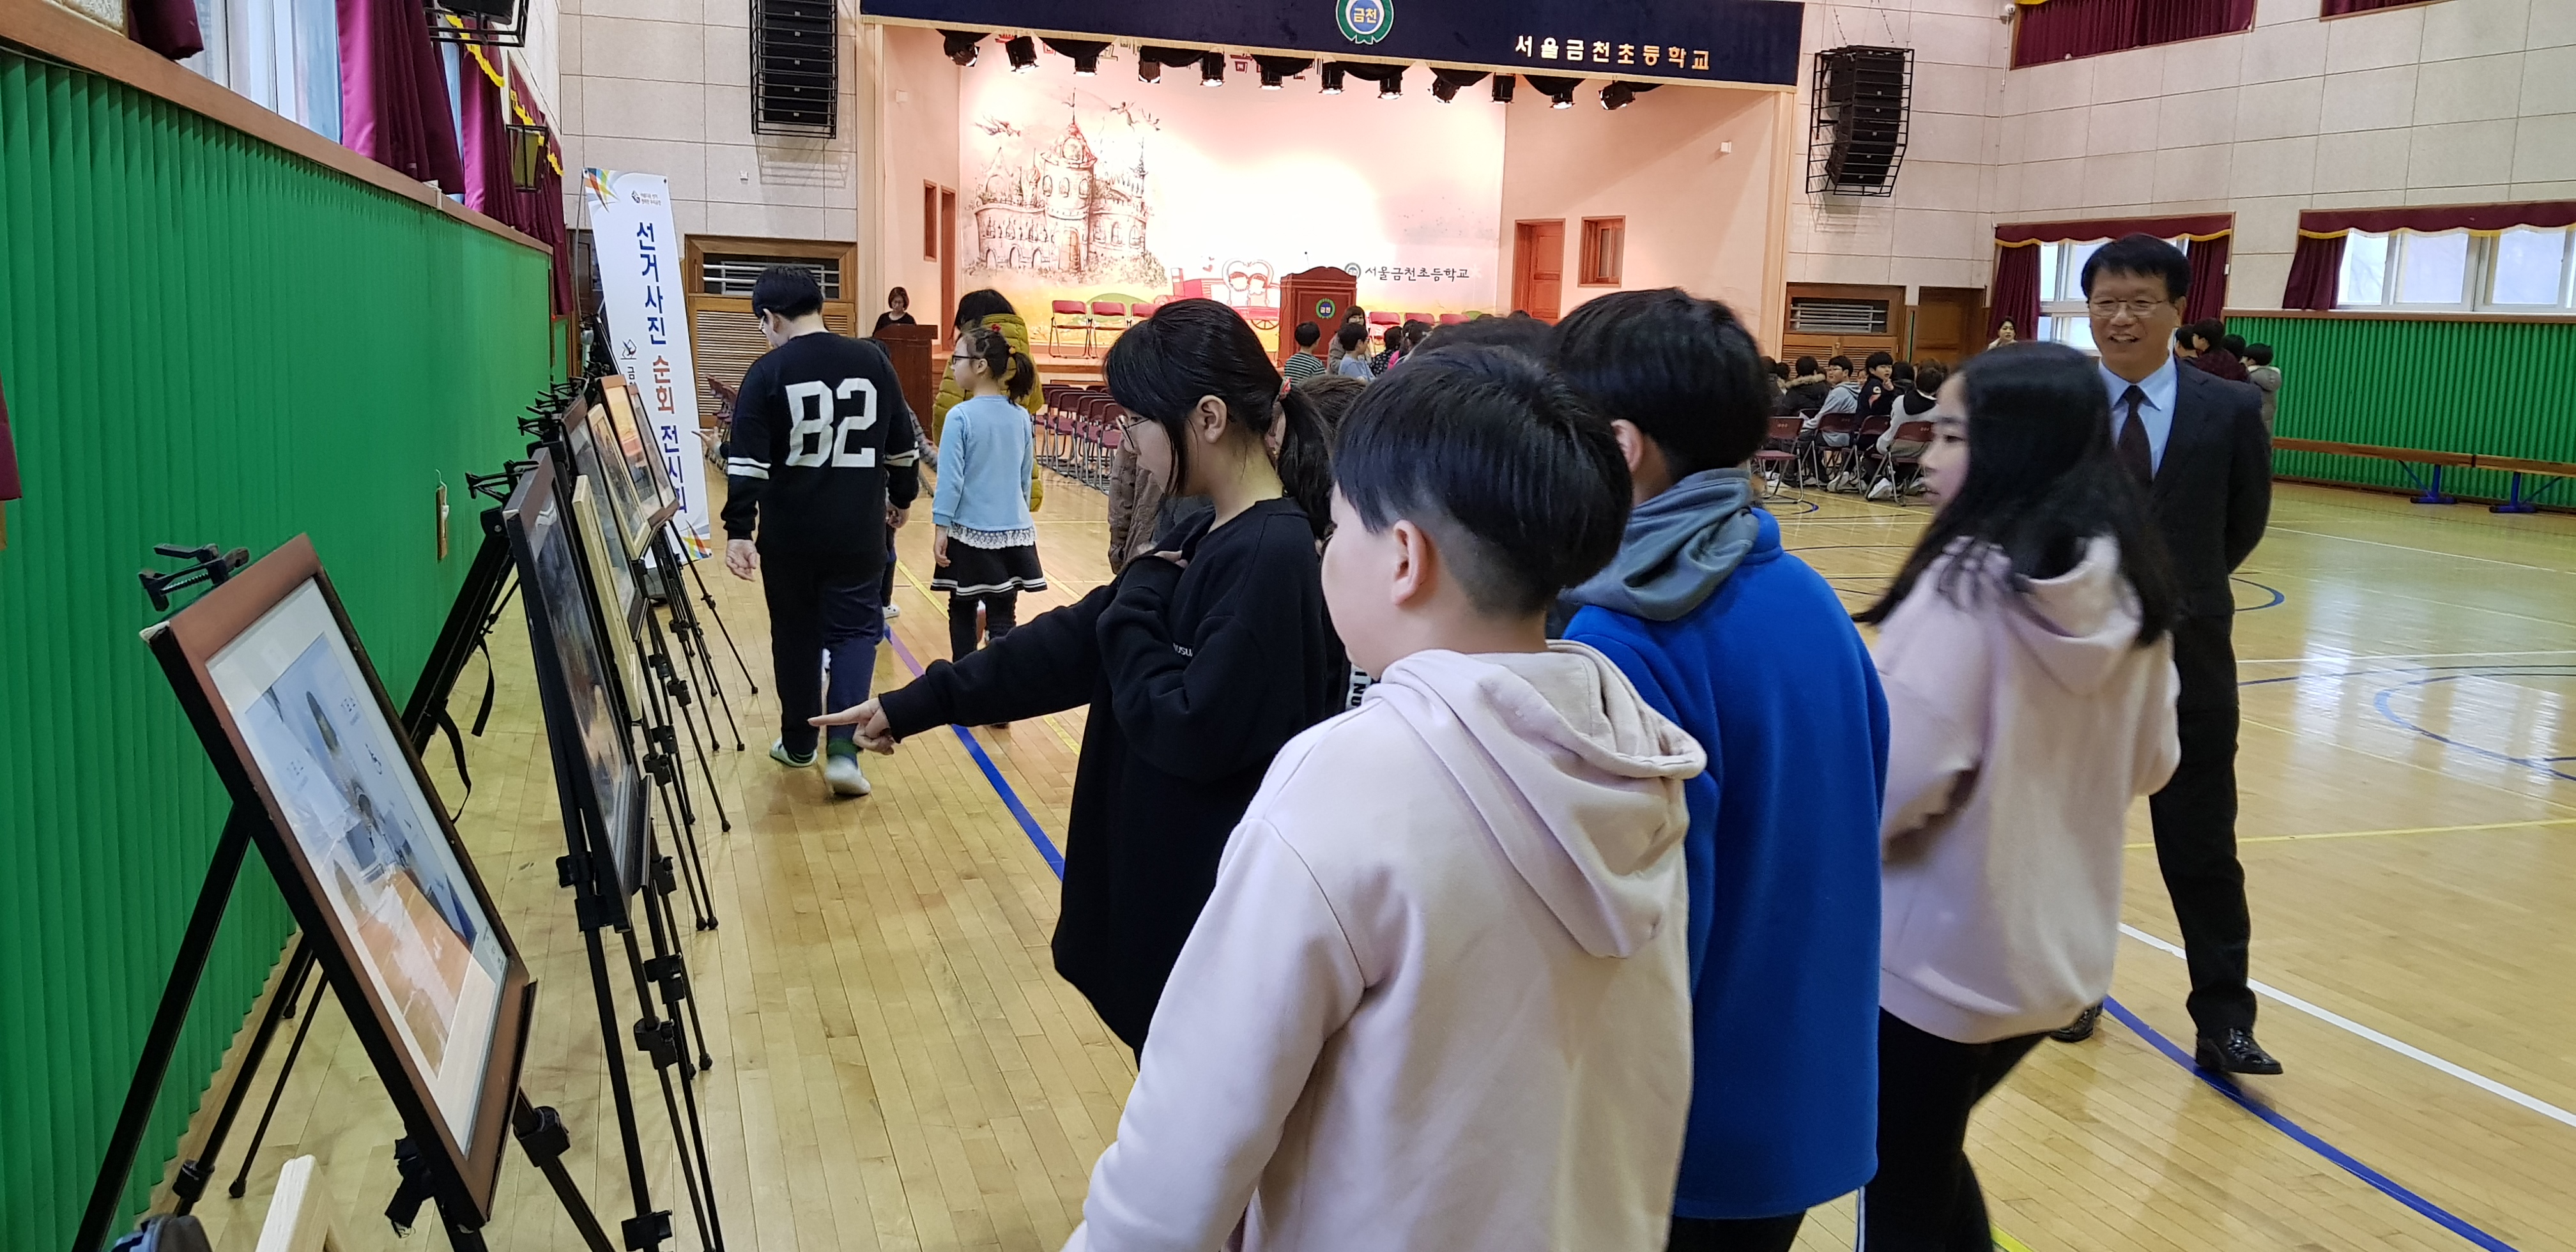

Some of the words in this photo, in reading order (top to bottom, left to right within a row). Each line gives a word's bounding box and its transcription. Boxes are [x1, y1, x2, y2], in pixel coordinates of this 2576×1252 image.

[1354, 8, 1377, 24] 금천
[1515, 35, 1710, 70] 서울금천초등학교
[1365, 266, 1470, 282] 서울금천초등학교
[637, 222, 666, 345] 선거사진
[653, 355, 675, 414] 순회
